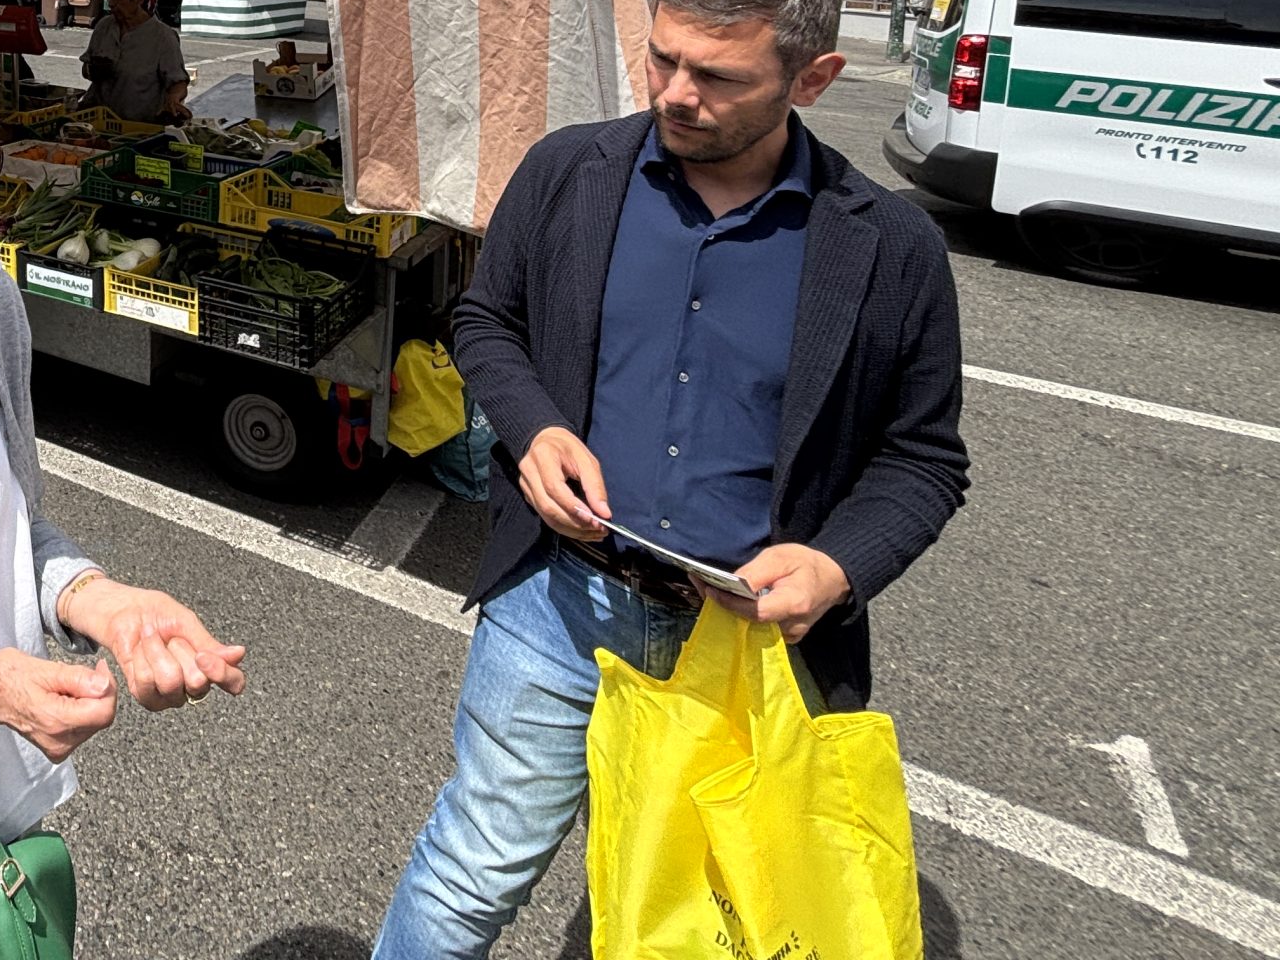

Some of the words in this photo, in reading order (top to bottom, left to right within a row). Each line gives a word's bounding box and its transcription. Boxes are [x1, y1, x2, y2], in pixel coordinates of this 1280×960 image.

[1095, 127, 1154, 142] PRONTO
[1155, 135, 1247, 153] INTERVENTO
[1150, 145, 1199, 164] 112
[42, 275, 90, 291] NOSTRANO
[471, 413, 488, 429] Ca
